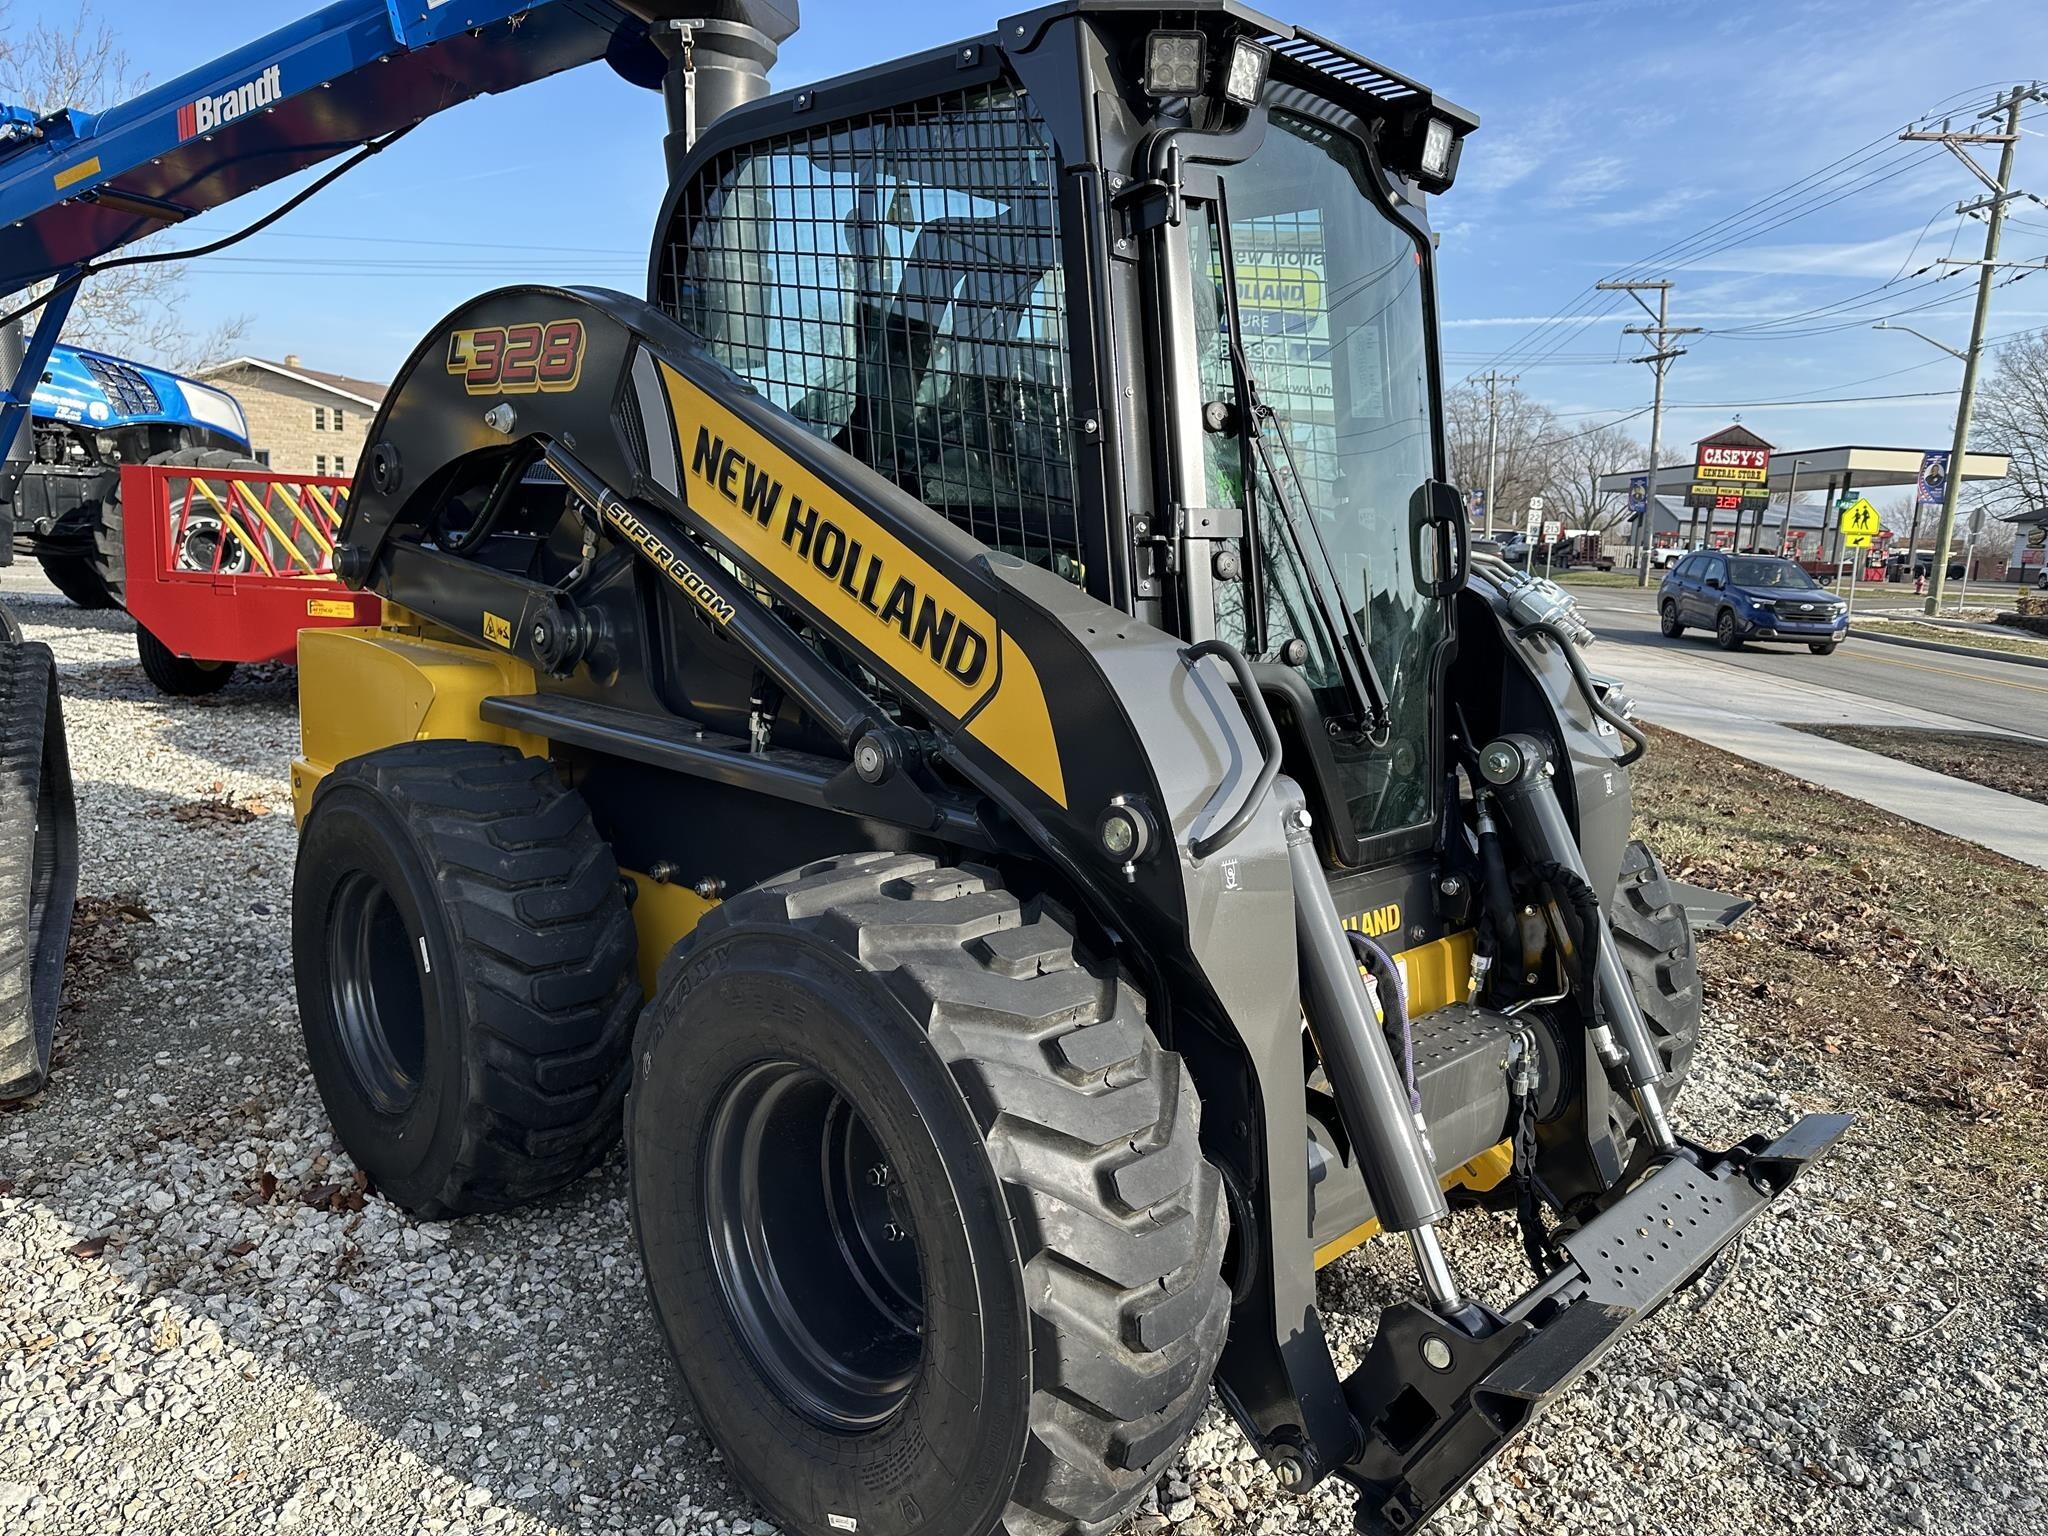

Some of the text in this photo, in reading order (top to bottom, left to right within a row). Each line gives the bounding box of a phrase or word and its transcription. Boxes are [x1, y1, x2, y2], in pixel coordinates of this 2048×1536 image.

[195, 64, 282, 135] Brandt
[1234, 246, 1325, 266] ew Holla
[447, 320, 585, 394] L328
[1282, 382, 1332, 395] www.nh
[1704, 448, 1765, 466] CASEY'S
[1703, 468, 1762, 480] GENERAL STORE
[1545, 525, 1559, 533] 213
[606, 502, 736, 626] SUPER BOOM
[691, 424, 988, 688] NEW HOLLAND
